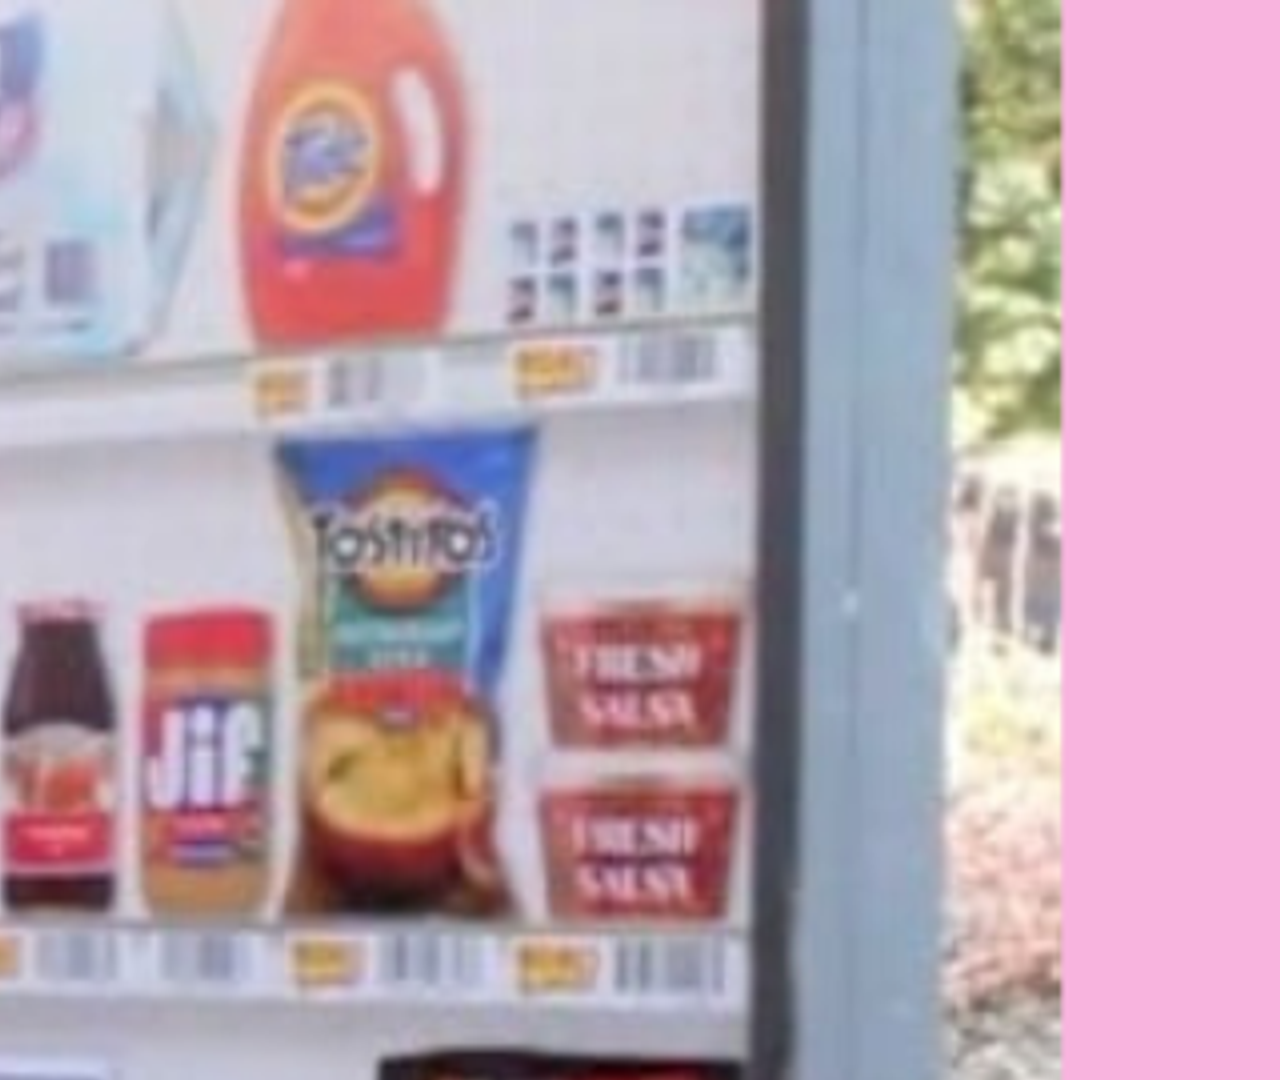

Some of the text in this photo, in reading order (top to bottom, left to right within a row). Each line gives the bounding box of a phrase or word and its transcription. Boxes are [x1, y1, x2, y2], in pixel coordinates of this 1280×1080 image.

[574, 640, 702, 686] FRESH
[580, 690, 698, 730] SALSA
[147, 698, 264, 808] Jif
[571, 812, 698, 858] FRESH
[578, 862, 696, 904] SALSA
